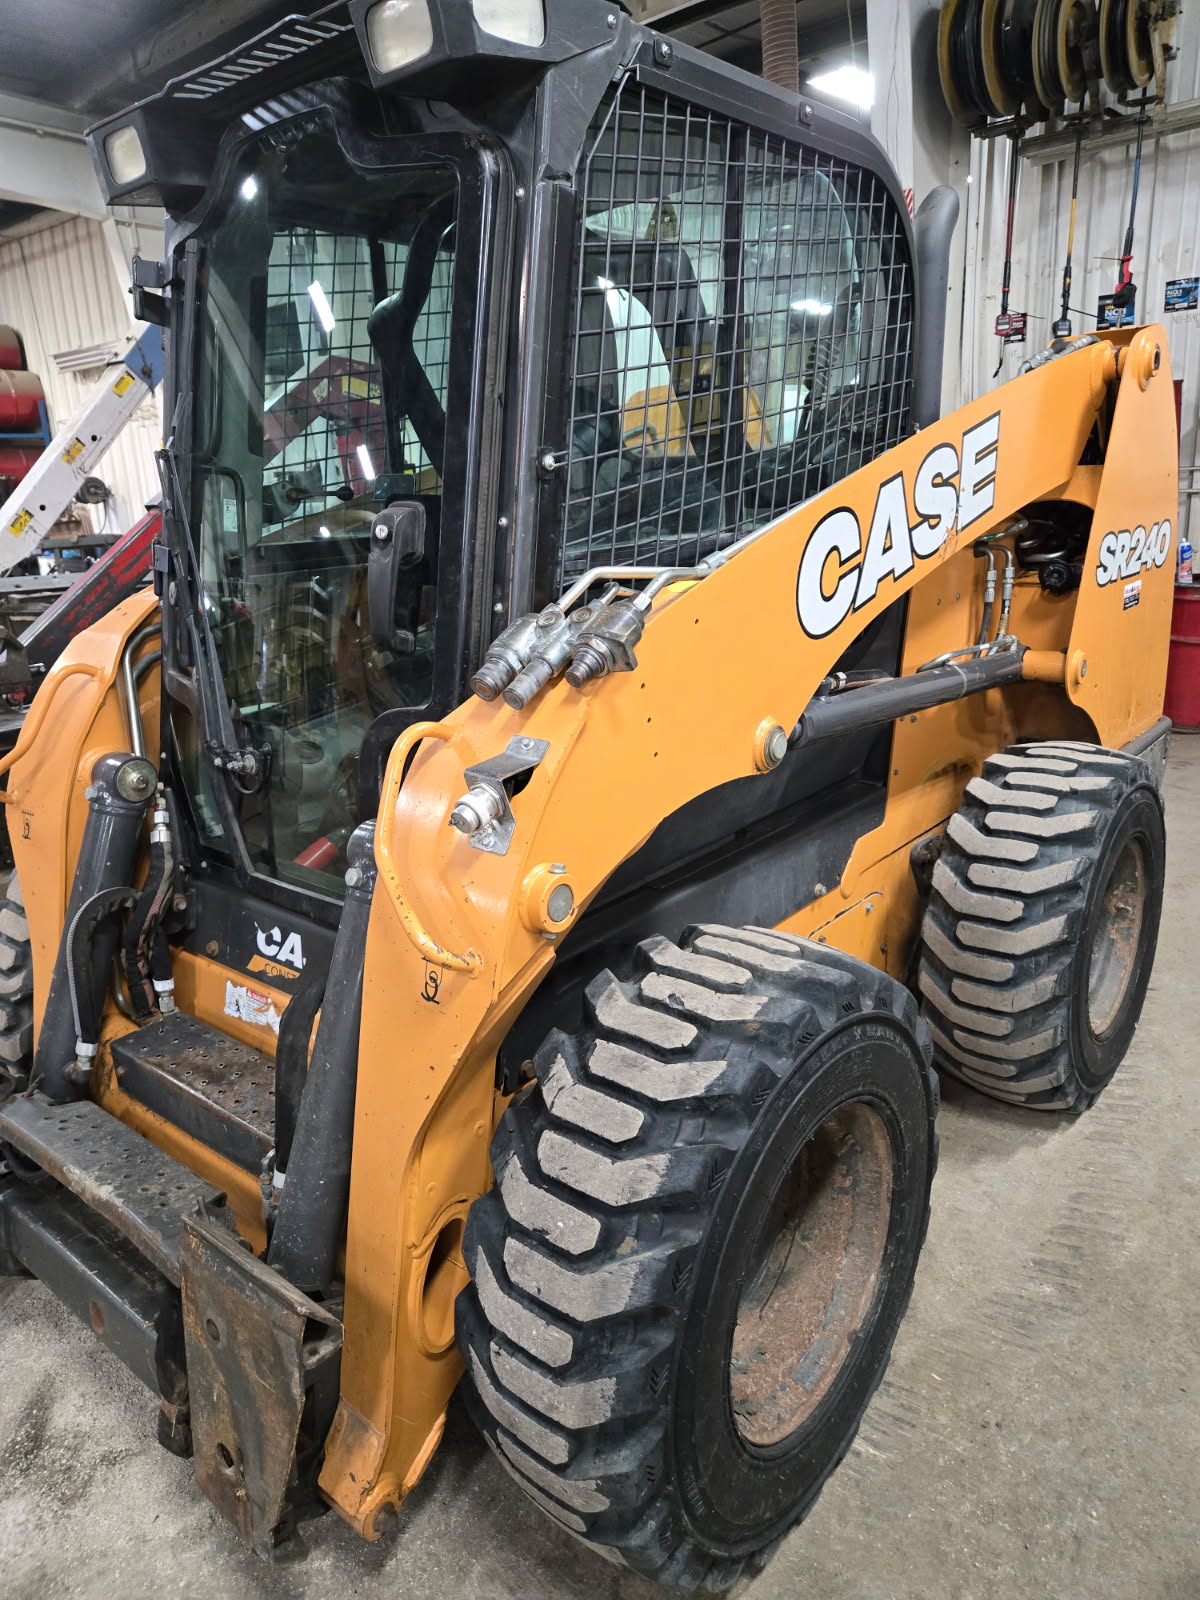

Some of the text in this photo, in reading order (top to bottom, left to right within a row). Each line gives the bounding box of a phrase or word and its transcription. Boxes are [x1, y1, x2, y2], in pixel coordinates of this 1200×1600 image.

[796, 409, 1001, 640] CASE
[1096, 519, 1171, 588] SR240
[254, 921, 307, 970] CA
